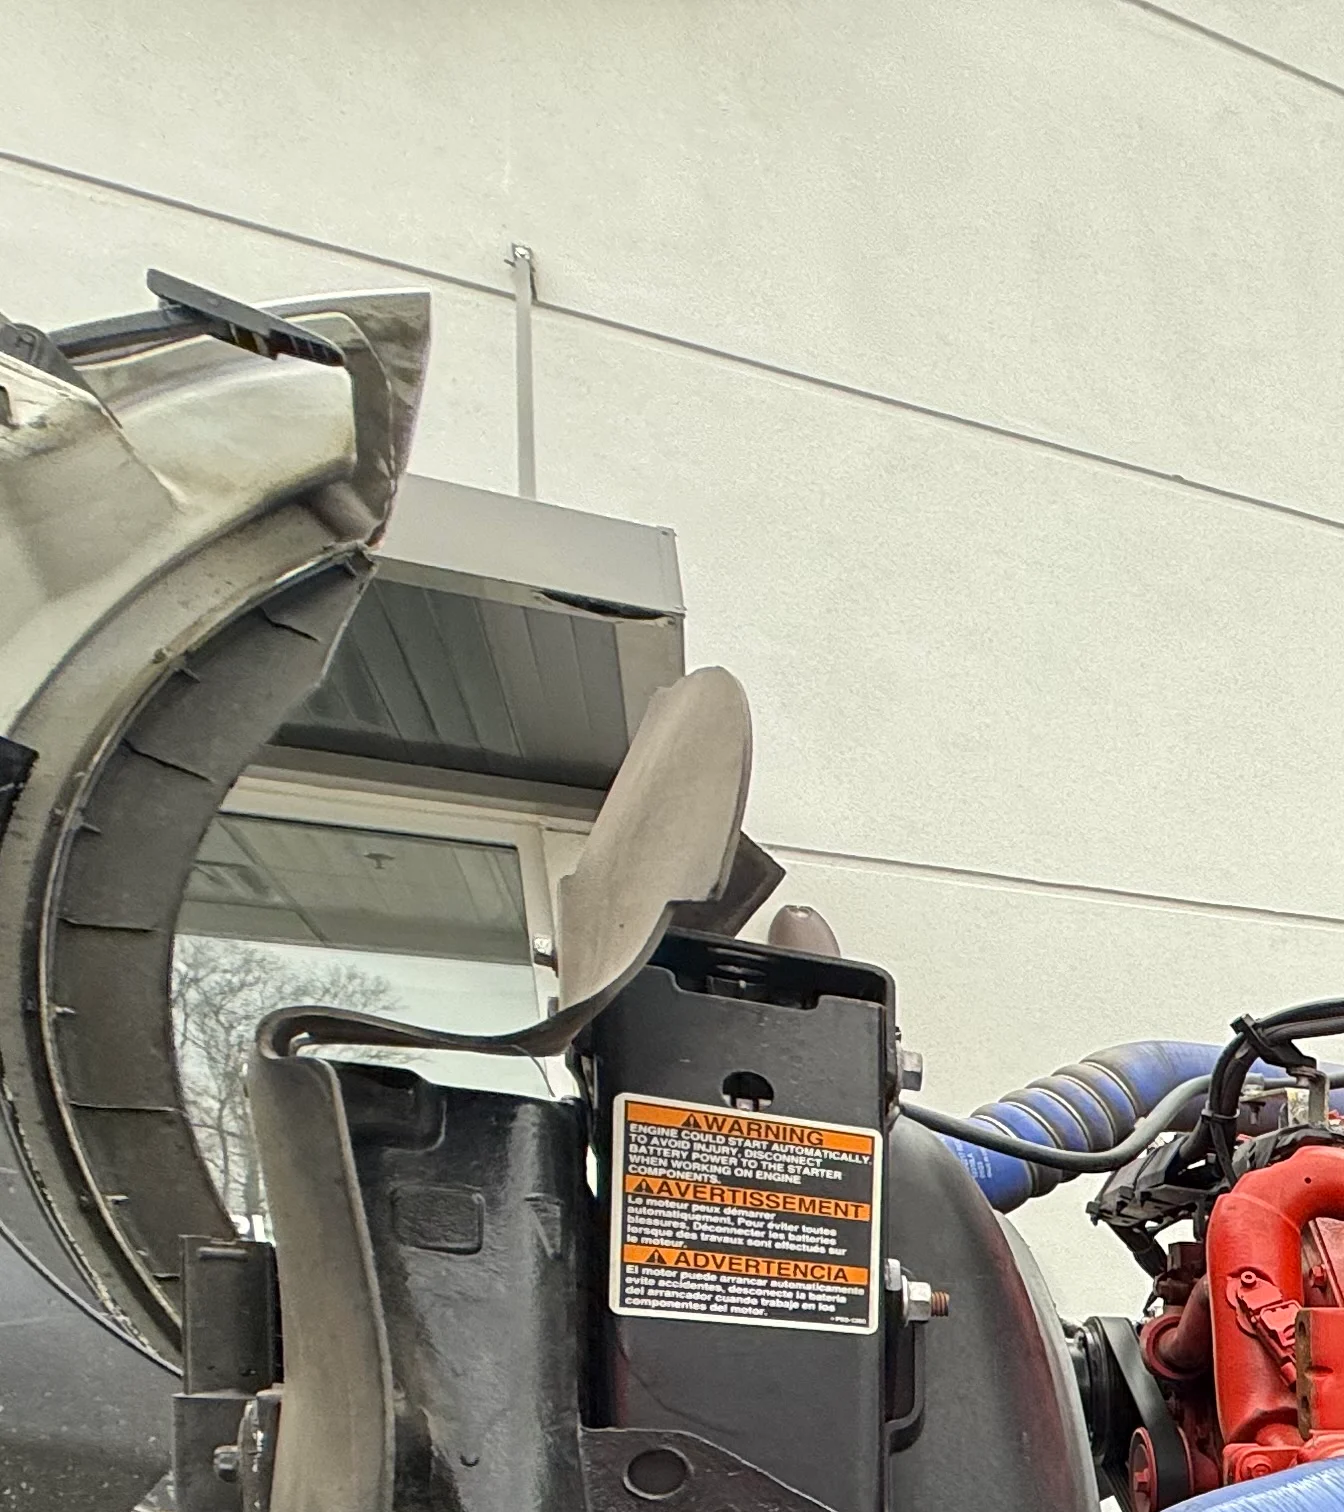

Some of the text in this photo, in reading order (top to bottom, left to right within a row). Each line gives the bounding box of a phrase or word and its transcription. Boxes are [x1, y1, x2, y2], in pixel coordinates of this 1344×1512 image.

[629, 1123, 679, 1138] ENGINE
[681, 1130, 725, 1145] COULD
[728, 1137, 768, 1151] START
[706, 1115, 824, 1146] WARNING
[629, 1133, 650, 1145] TO
[652, 1136, 691, 1150] AVOID
[744, 1149, 822, 1168] DISCONNECT
[629, 1143, 842, 1180] BATTERY POWER TO THE STARTER
[628, 1164, 721, 1185] COMPONENTS.
[629, 1154, 801, 1185] WHEN WORKING ON ENGINE
[628, 1195, 643, 1205] Le
[646, 1198, 689, 1210] moteur
[724, 1207, 776, 1220] démarrer
[657, 1180, 864, 1219] AVERTISSEMENT
[627, 1235, 638, 1244] le
[627, 1225, 673, 1238] lorsque
[676, 1230, 698, 1240] des
[701, 1233, 744, 1245] travaux
[747, 1238, 772, 1248] sont
[828, 1246, 847, 1256] sur
[693, 1222, 765, 1238] Déconnecter
[768, 1231, 785, 1240] les
[788, 1233, 837, 1246] batteries
[738, 1218, 764, 1229] Pour
[802, 1225, 837, 1237] toutes
[626, 1265, 638, 1275] El
[642, 1267, 677, 1278] motor
[681, 1271, 717, 1282] puede
[720, 1274, 768, 1287] arrancar
[675, 1251, 849, 1283] ADVERTENCIA
[625, 1286, 835, 1312] del arrancador cuando trabaje en los
[626, 1276, 655, 1287] evite
[728, 1285, 793, 1299] desconecte
[797, 1291, 806, 1300] la
[625, 1296, 707, 1311] componentes
[710, 1304, 727, 1313] del
